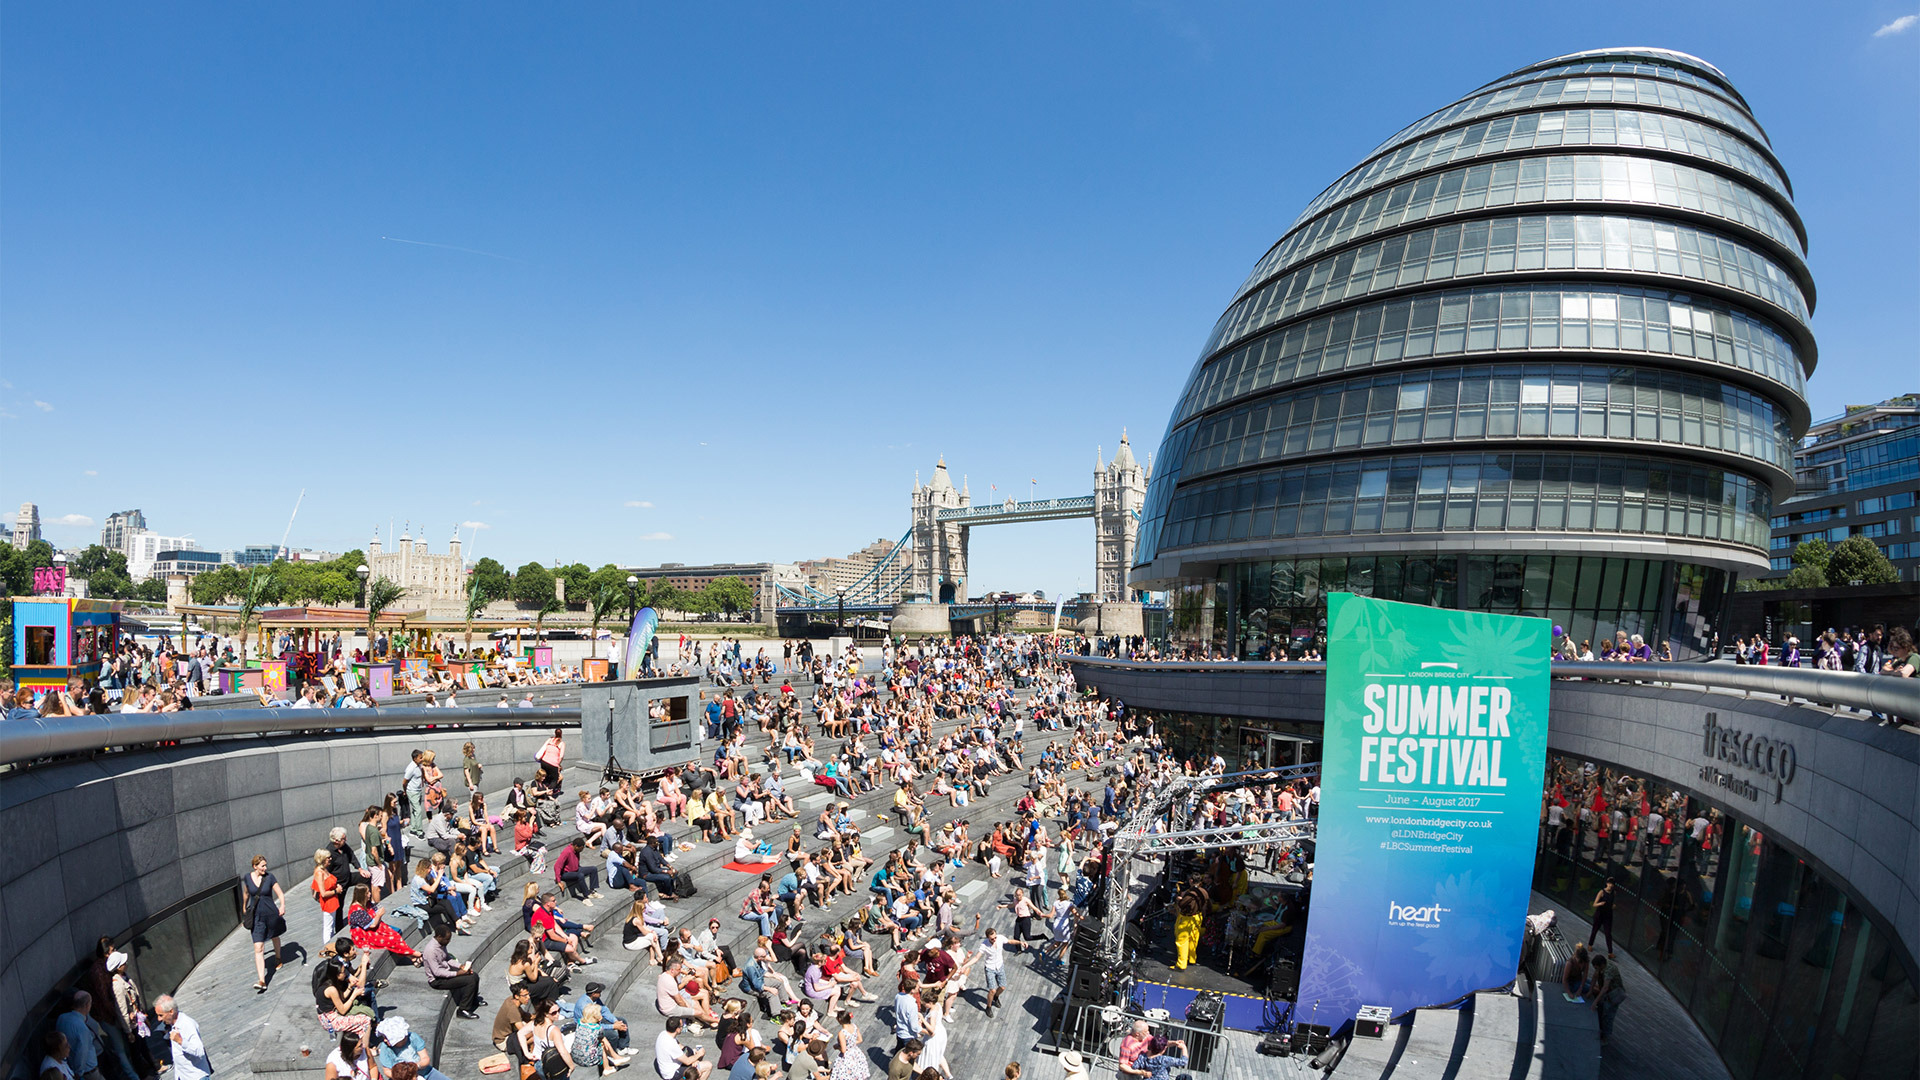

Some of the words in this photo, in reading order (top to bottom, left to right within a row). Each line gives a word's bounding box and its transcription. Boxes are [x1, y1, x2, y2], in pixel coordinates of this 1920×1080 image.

[1362, 683, 1512, 738] SUMMER
[1359, 736, 1507, 787] FESTIVAL
[1384, 794, 1410, 805] June
[1421, 796, 1456, 808] August
[1457, 797, 1481, 807] 2017
[1365, 816, 1493, 829] www.londonbridgecity.co.uk
[1391, 829, 1464, 842] @LDNBridgeCity
[1380, 842, 1473, 854] #LBCSummerFestival
[1388, 900, 1441, 922] heart
